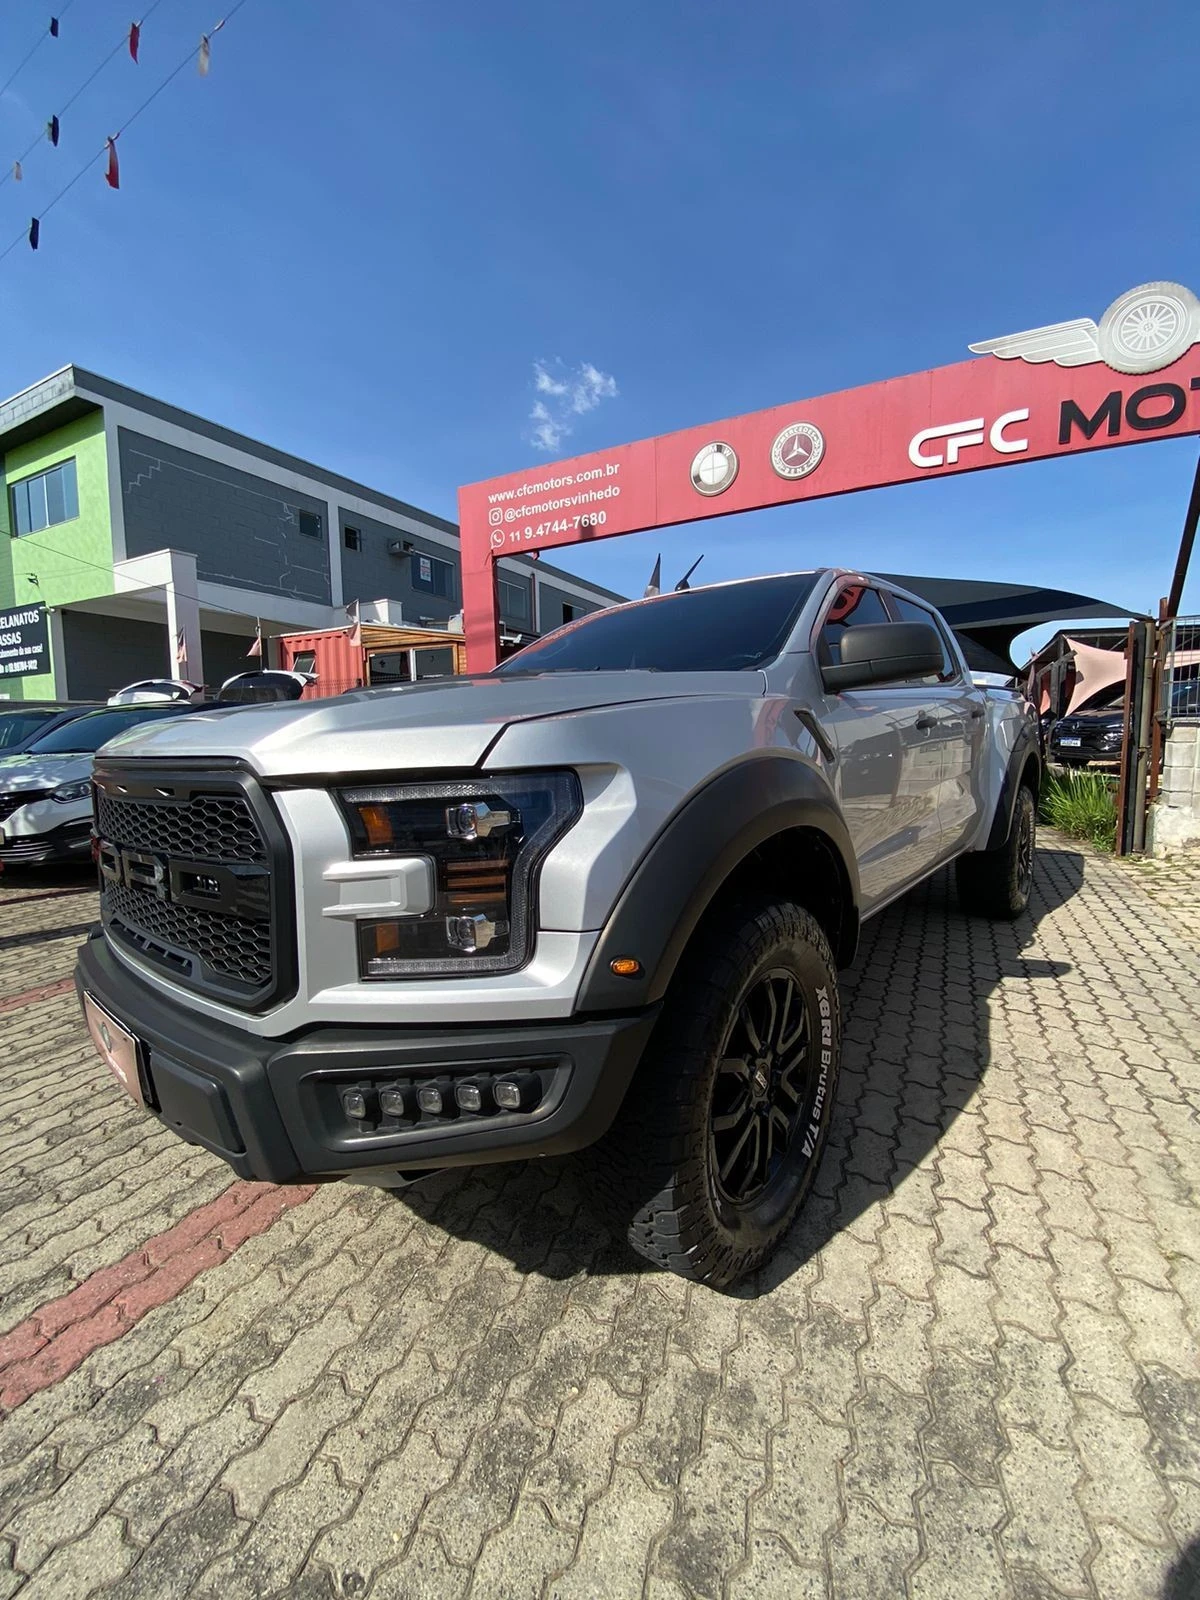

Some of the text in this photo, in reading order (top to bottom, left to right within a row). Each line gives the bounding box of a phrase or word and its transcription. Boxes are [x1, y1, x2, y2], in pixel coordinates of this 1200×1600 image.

[908, 377, 1200, 468] CFC MO
[488, 463, 620, 504] www.cfcmotors.com.br
[504, 485, 621, 523] @cfcmotorsvinhedo
[509, 510, 607, 542] 11 9.4744-7680
[801, 985, 832, 1158] XBRI Brutus T/A
